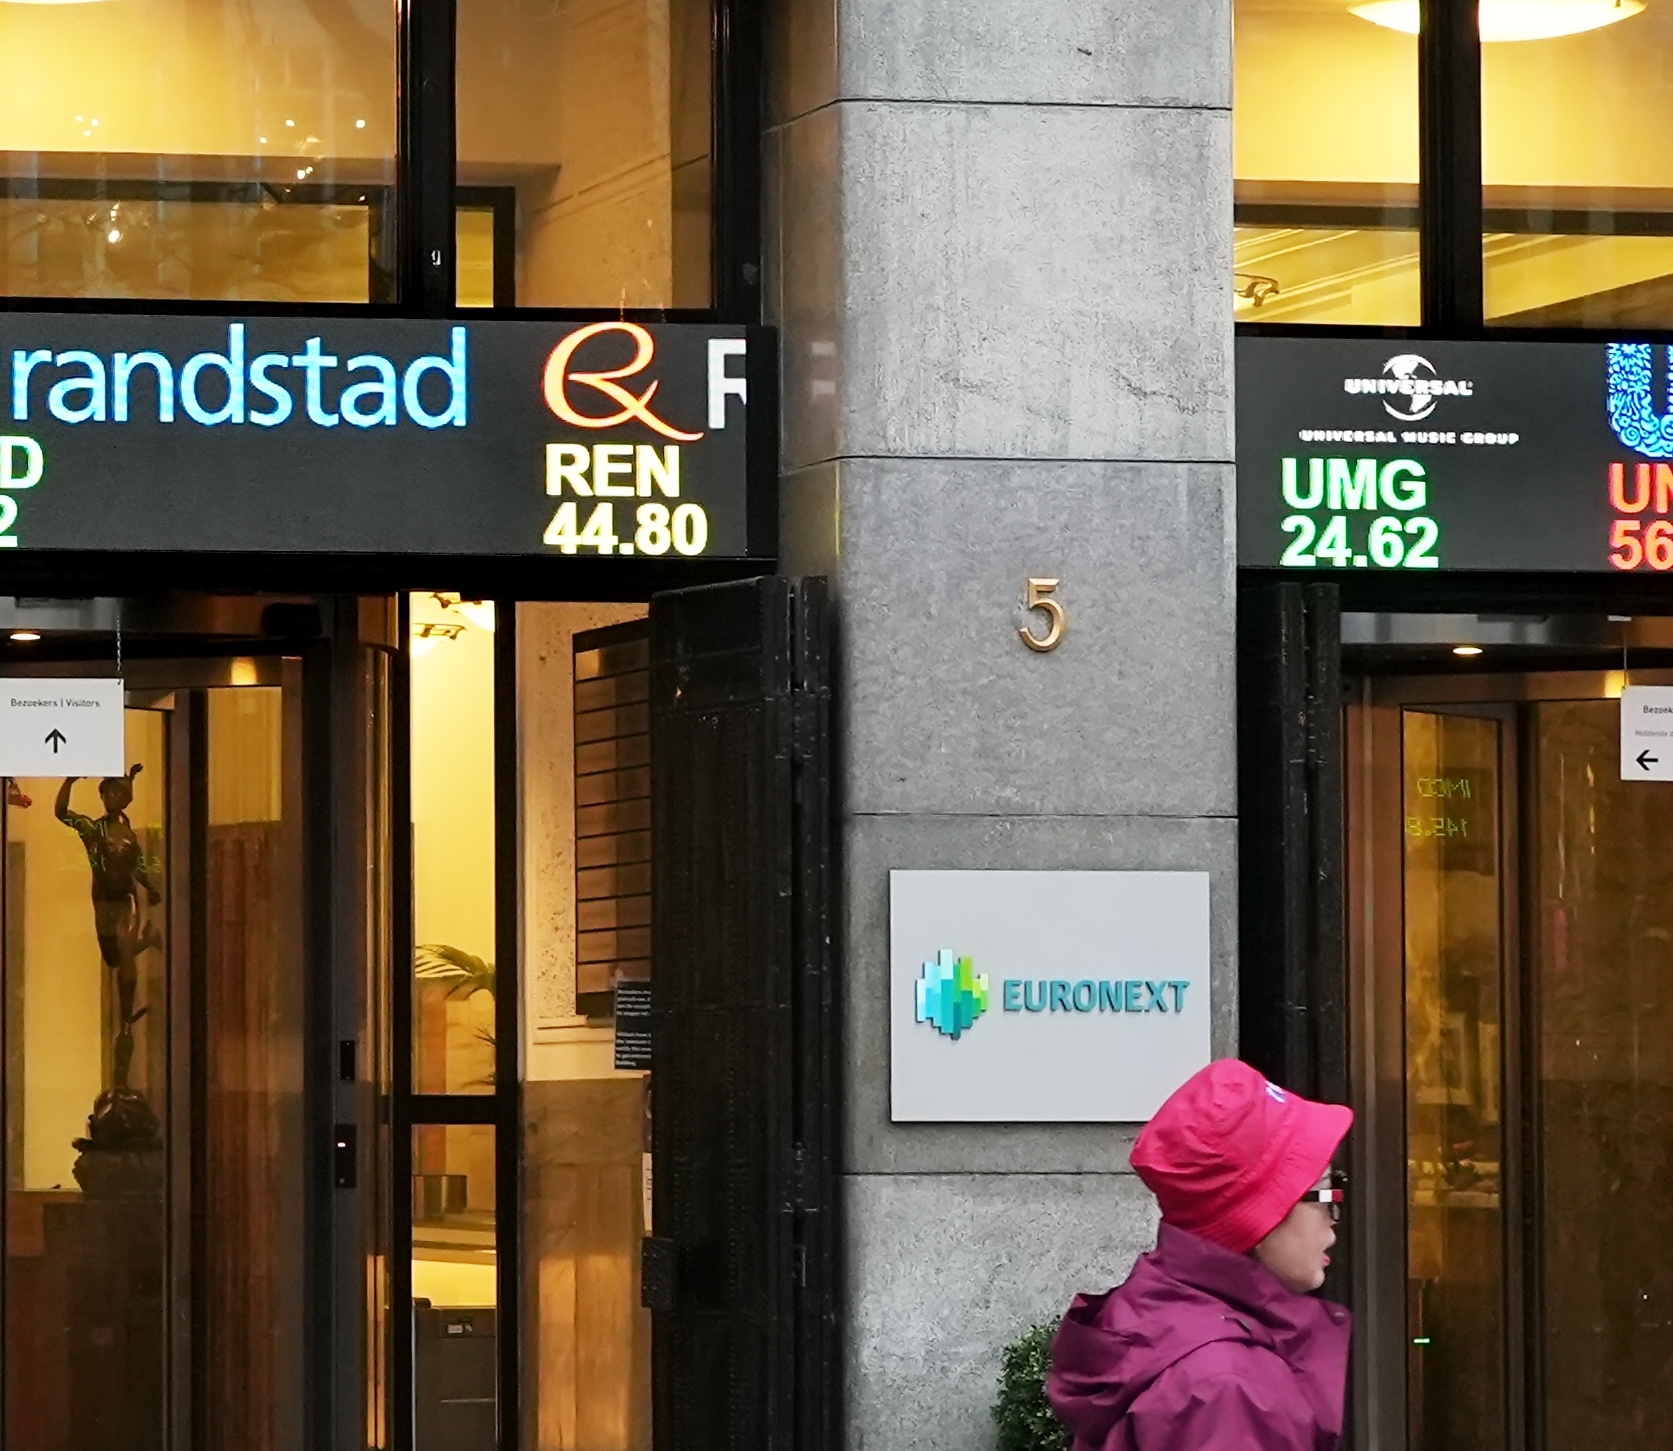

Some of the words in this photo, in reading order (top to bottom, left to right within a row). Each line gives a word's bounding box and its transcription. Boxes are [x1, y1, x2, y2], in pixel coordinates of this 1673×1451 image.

[12, 323, 467, 429] randstad
[1299, 430, 1397, 443] UNIVERSAL
[1401, 432, 1456, 444] MUSIC
[1460, 433, 1520, 445] GROUP
[546, 444, 680, 498] REN
[1282, 458, 1426, 511] UMG
[543, 502, 708, 556] 44.80
[1280, 515, 1439, 569] 24.62
[1019, 577, 1065, 652] 5
[10, 698, 58, 707] Bezoekers
[65, 698, 100, 707] Visitors
[1003, 979, 1190, 1014] EURONEXT
